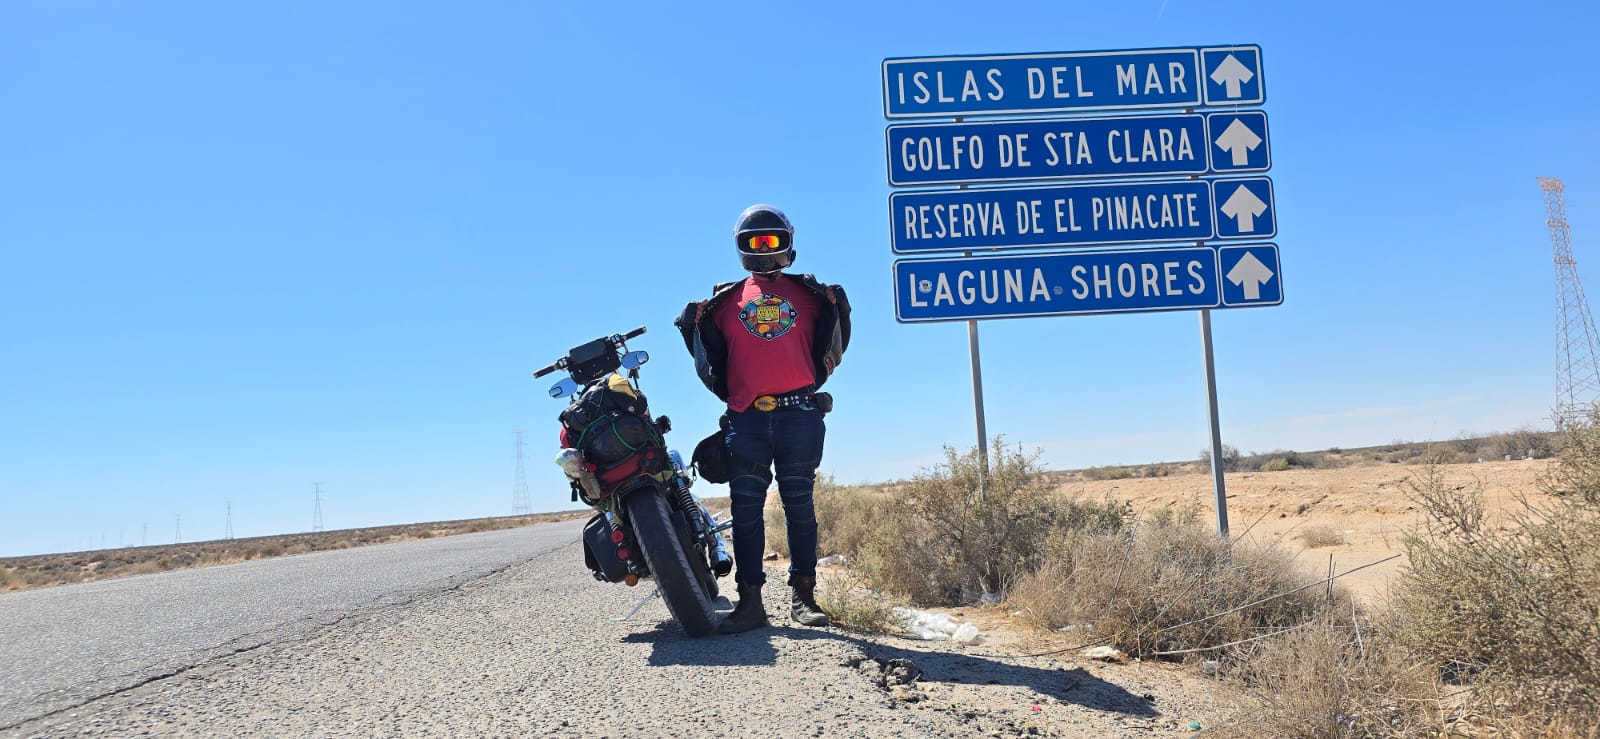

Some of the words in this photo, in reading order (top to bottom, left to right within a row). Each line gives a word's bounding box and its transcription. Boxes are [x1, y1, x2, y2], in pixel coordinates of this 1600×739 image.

[898, 68, 1004, 104] ISLAS
[1027, 65, 1094, 99] DEL
[1115, 62, 1187, 96] MAR
[901, 135, 984, 172] GOLFO
[998, 133, 1031, 168] DE
[1043, 131, 1093, 166] STA
[1108, 127, 1194, 164] CLARA
[904, 202, 1006, 240] RESERVA
[1016, 200, 1044, 235] DE
[1054, 198, 1082, 233] EL
[1092, 193, 1200, 231] PINACATE
[909, 268, 1051, 308] LAGUNA
[1071, 260, 1206, 301] SHORES
